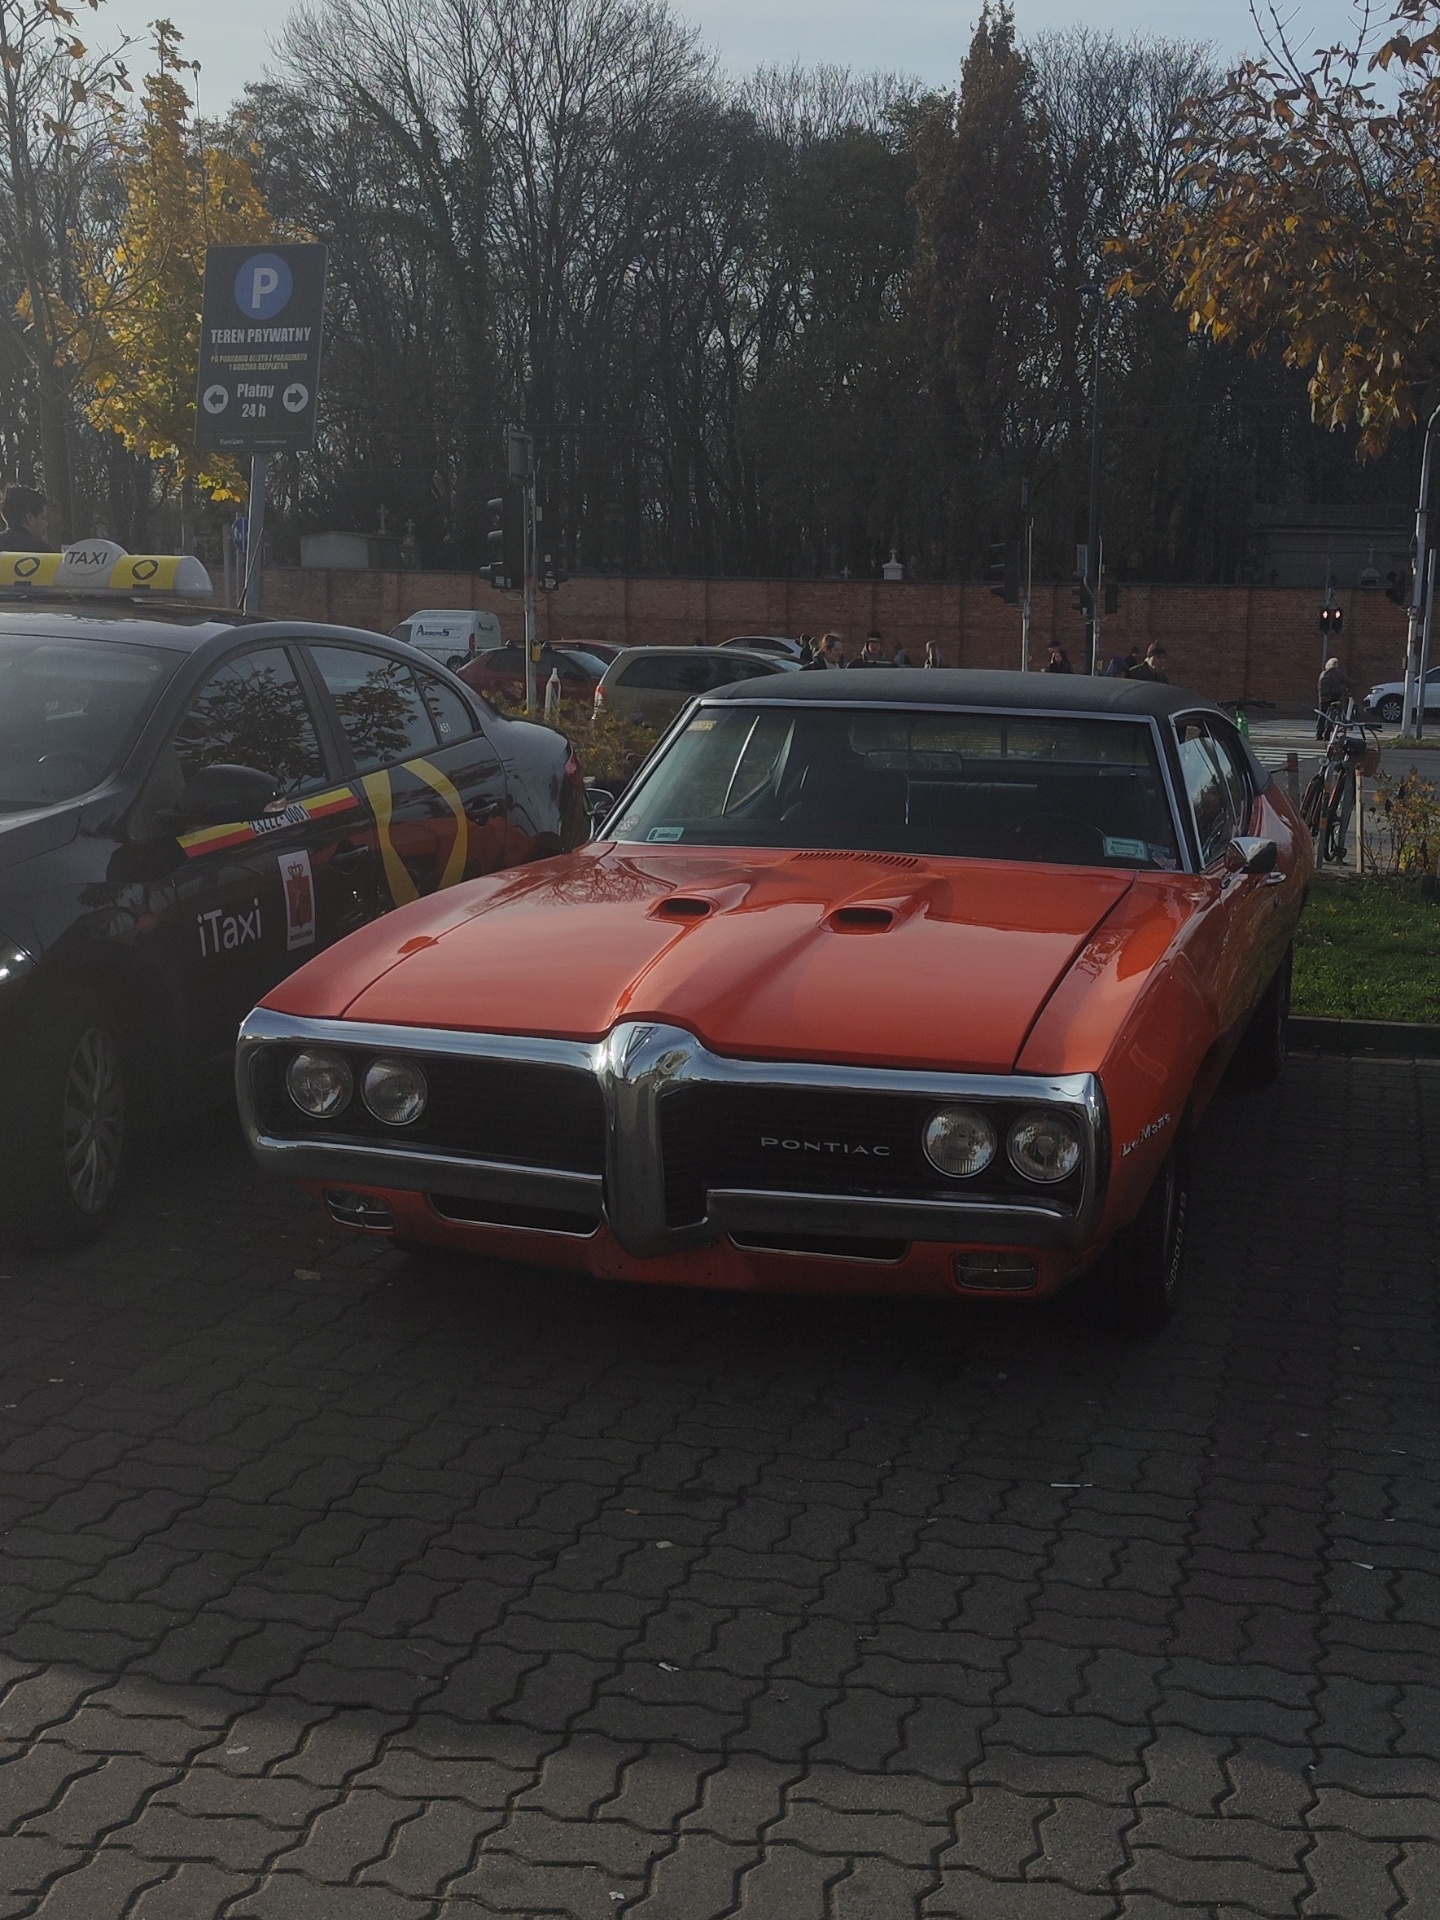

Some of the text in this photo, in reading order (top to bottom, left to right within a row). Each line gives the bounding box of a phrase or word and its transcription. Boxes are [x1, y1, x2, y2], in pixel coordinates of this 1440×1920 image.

[252, 268, 279, 308] P
[211, 327, 312, 343] TEREN PRYWATNY
[237, 383, 274, 398] Płatny
[67, 551, 108, 565] TAXI
[197, 897, 262, 957] iTaxi
[760, 1136, 890, 1156] PONTIAC
